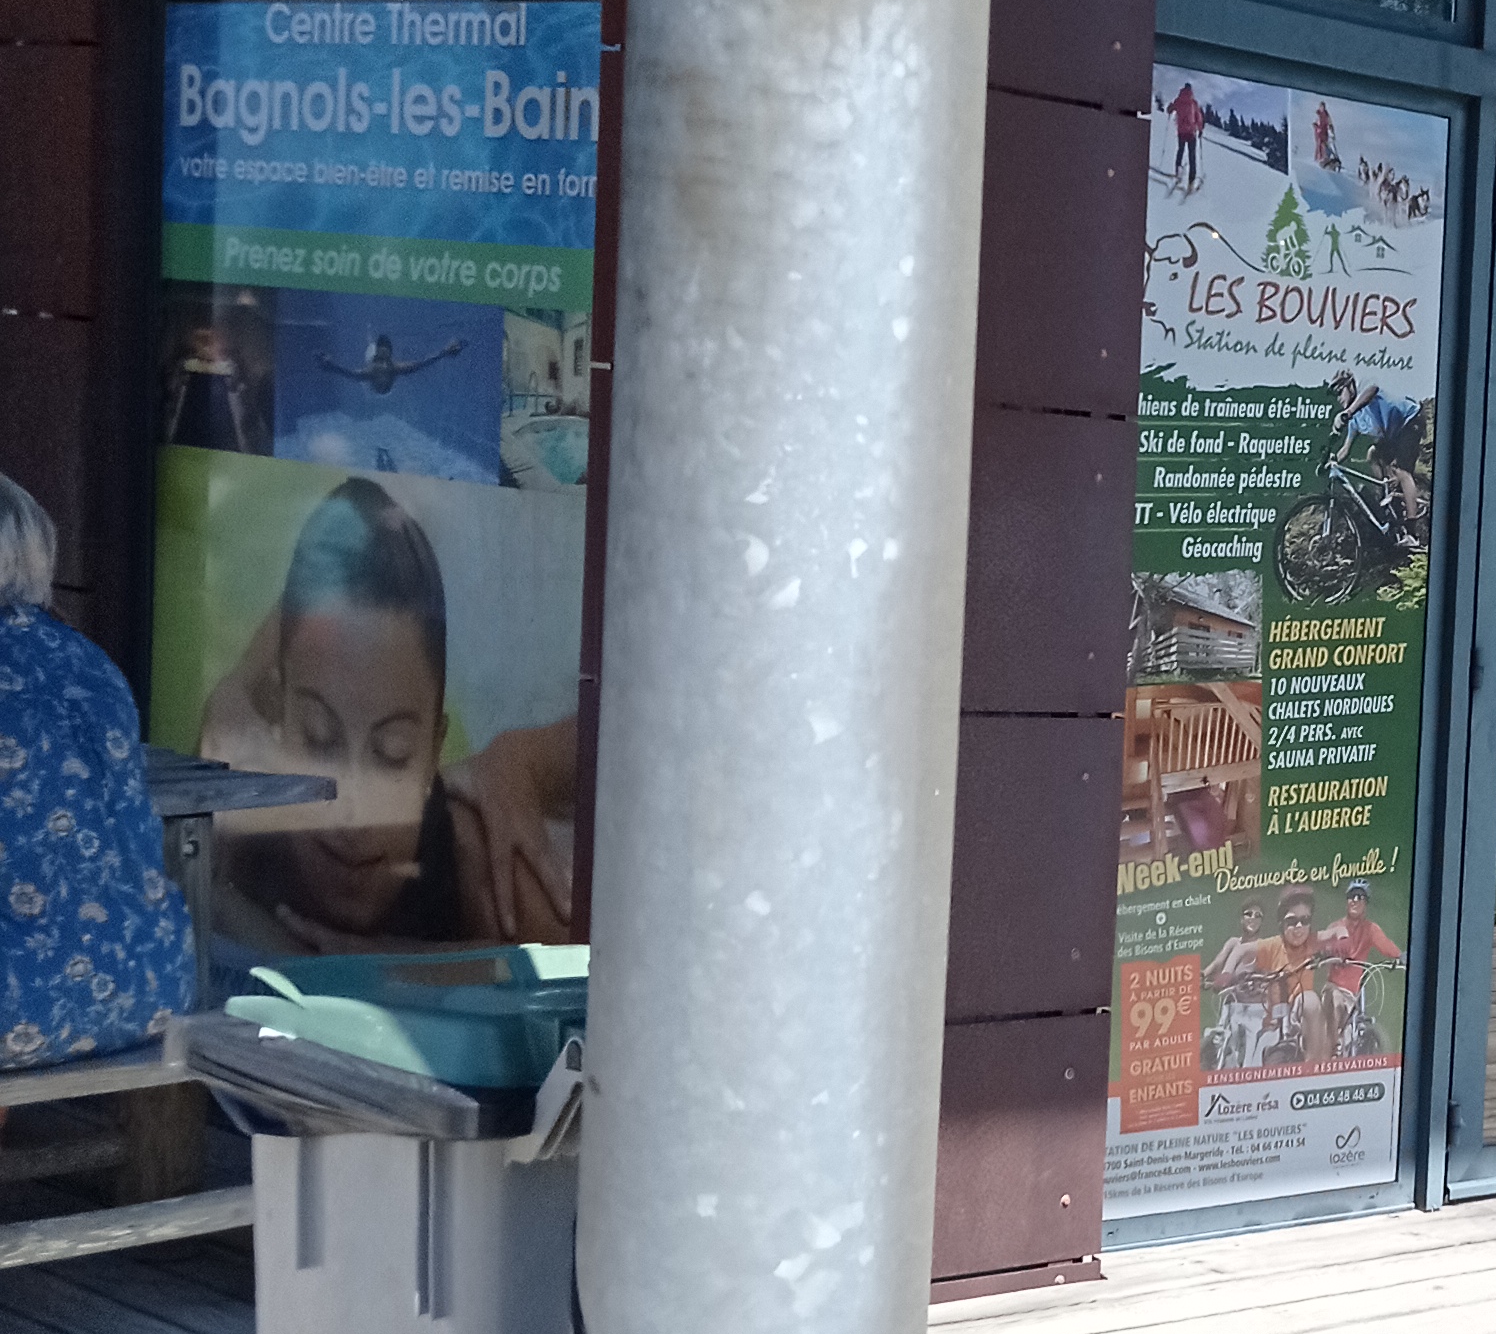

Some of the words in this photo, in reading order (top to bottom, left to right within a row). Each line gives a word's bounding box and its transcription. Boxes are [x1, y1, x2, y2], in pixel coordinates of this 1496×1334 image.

[266, 3, 376, 44] Centre
[386, 2, 527, 47] Thermal
[181, 153, 227, 179] votre
[234, 159, 308, 185] espace
[414, 162, 434, 188] et
[441, 168, 515, 194] remise
[522, 173, 551, 196] en
[225, 238, 306, 270] Prenez
[313, 243, 360, 276] soin
[369, 247, 400, 280] de
[409, 252, 476, 286] votre
[484, 262, 562, 298] corps
[1188, 270, 1245, 318] LES
[1256, 280, 1417, 339] BOUVIERS
[1183, 320, 1258, 358] Station
[1264, 330, 1286, 357] de
[1291, 335, 1347, 369] pleine
[1354, 341, 1414, 371] nature
[1137, 392, 1177, 417] hiens
[1181, 394, 1199, 417] de
[1204, 397, 1264, 418] traîneau
[1268, 397, 1332, 420] été-hiver
[1139, 430, 1163, 453] Ski
[1167, 430, 1185, 453] de
[1190, 431, 1225, 453] fond
[1238, 432, 1311, 459] Raquettes
[1153, 467, 1235, 488] Randonnée
[1238, 467, 1302, 495] pédestre
[1169, 501, 1201, 523] Vélo
[1206, 501, 1276, 529] électrique
[1182, 535, 1263, 563] Géocaching
[1269, 615, 1386, 643] HÉBERGEMENT
[1268, 648, 1329, 669] GRAND
[1333, 642, 1407, 666] CONFORT
[1269, 678, 1287, 696] 10
[1290, 673, 1366, 695] NOUVEAUX
[1268, 700, 1321, 720] CHALETS
[1323, 694, 1395, 717] NORDIQUES
[1268, 725, 1297, 747] 2/4
[1300, 723, 1337, 743] PERS.
[1340, 726, 1363, 739] AVEC
[1268, 748, 1314, 770] SAUNA
[1318, 744, 1377, 767] PRIVATIF
[1268, 776, 1389, 806] RESTAURATION
[1267, 809, 1280, 835] À
[1285, 805, 1373, 833] L'AUBERGE
[1213, 858, 1308, 893] Découverte
[1311, 864, 1329, 880] en
[1331, 849, 1386, 887] famille
[1172, 899, 1182, 909] en
[1185, 894, 1211, 906] chalet
[1119, 931, 1143, 944] Visite
[1145, 928, 1156, 940] de
[1158, 927, 1167, 938] la
[1169, 924, 1203, 936] Réserve
[1117, 947, 1132, 958] des
[1135, 943, 1163, 956] Bisons
[1165, 937, 1204, 952] d'Europe
[1130, 973, 1140, 988] 2
[1146, 965, 1193, 987] NUITS
[1140, 987, 1175, 1000] PARTIR
[1179, 985, 1193, 994] DE
[1129, 1040, 1150, 1051] PAR
[1154, 1033, 1193, 1048] ADULTE
[1129, 1052, 1193, 1076] GRATUIT
[1207, 1065, 1302, 1084] RENSEIGNEMENTS
[1314, 1057, 1388, 1074] RÉSERVATIONS
[1129, 1080, 1193, 1104] ENFANTS
[1217, 1098, 1252, 1116] Lozère
[1257, 1092, 1279, 1112] résa
[1307, 1093, 1320, 1106] 04
[1322, 1091, 1335, 1104] 66
[1337, 1089, 1350, 1102] 48
[1352, 1088, 1364, 1100] 48
[1366, 1086, 1379, 1099] 48
[1141, 1141, 1156, 1153] DE
[1157, 1137, 1191, 1151] PLEINE
[1193, 1132, 1230, 1147] NATURE
[1250, 1142, 1261, 1153] 04
[1273, 1140, 1284, 1150] 47
[1329, 1149, 1366, 1165] lozère
[1131, 1186, 1142, 1196] de
[1143, 1184, 1152, 1194] la
[1154, 1180, 1185, 1193] Réserve
[1187, 1178, 1200, 1189] des
[1202, 1175, 1228, 1187] Bisons
[1230, 1171, 1264, 1185] d'Europe
